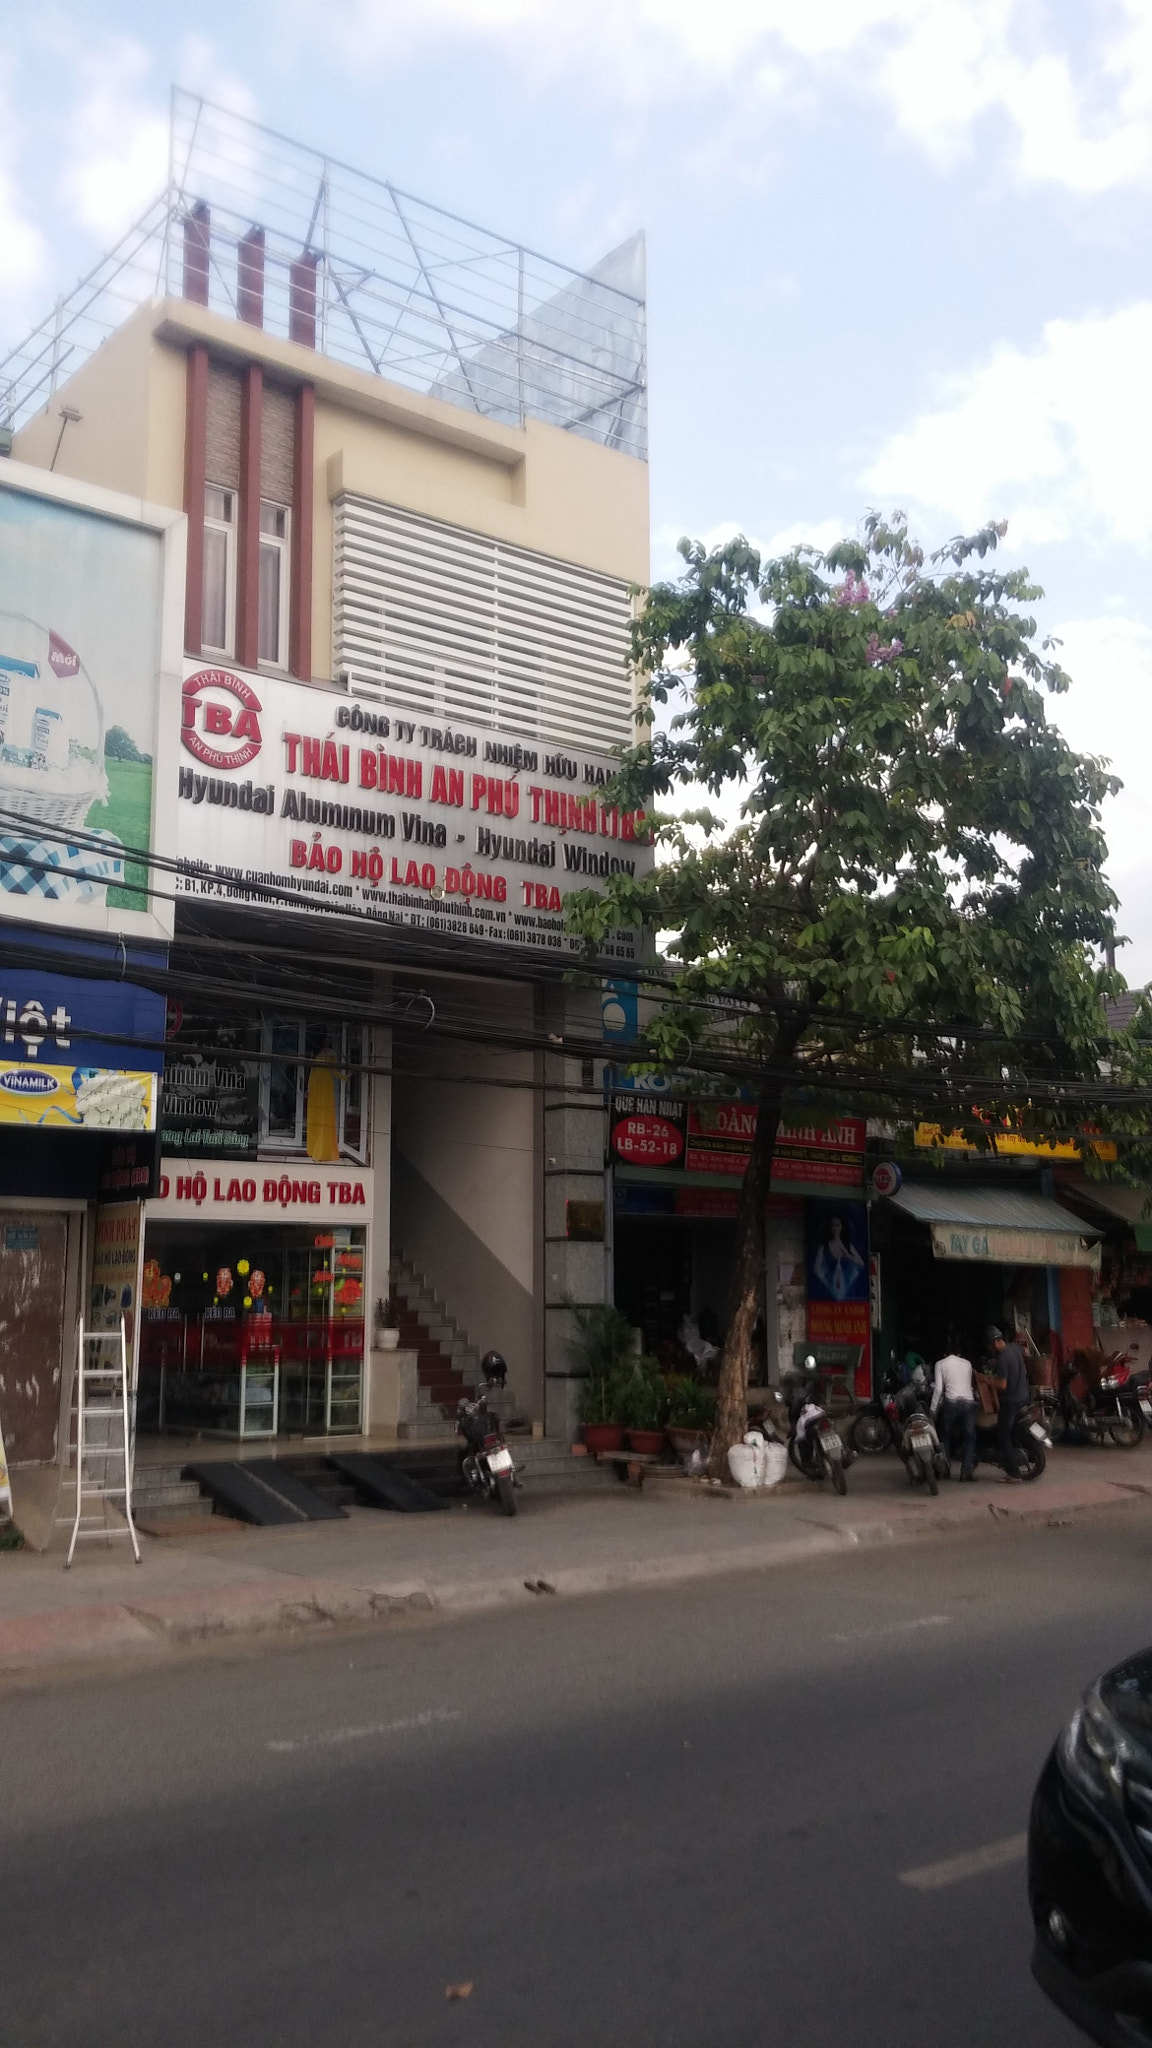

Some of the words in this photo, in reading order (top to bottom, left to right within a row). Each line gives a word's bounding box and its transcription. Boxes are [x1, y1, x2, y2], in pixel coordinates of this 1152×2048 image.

[193, 671, 221, 687] THÁI
[182, 696, 262, 743] TBA
[188, 736, 203, 751] AN
[202, 747, 223, 762] PHÚ
[224, 747, 253, 764] THỊNH
[336, 703, 390, 738] CÔNG
[394, 719, 417, 744] TY
[419, 726, 477, 757] TRÁCH
[483, 740, 538, 774] NHIỆM
[543, 752, 578, 781] HỮU
[282, 731, 350, 784] THÁI
[358, 743, 423, 799] BÌNH
[430, 764, 464, 807] AN
[471, 774, 520, 819] PHÚ
[527, 785, 598, 836] THỊNH
[600, 802, 655, 847] (TB
[178, 766, 275, 815] Hyundai
[280, 788, 396, 839] Aluminum
[401, 811, 447, 848] Vina
[475, 826, 556, 868] Hyundai
[562, 843, 636, 877] Window
[176, 856, 213, 876] ebsite:
[289, 831, 343, 874] BẢO
[350, 846, 384, 888] HỘ
[389, 856, 436, 890] LAO
[441, 862, 507, 904] ĐỘNG
[520, 880, 562, 912] TBA
[0, 996, 72, 1058] iệt
[3, 1074, 55, 1090] VINAMILK
[214, 1066, 246, 1091] Vina
[627, 1121, 669, 1137] RB-26
[703, 1107, 758, 1134] OÀN
[616, 1137, 677, 1155] LB-52-18
[176, 1170, 207, 1206] HỘ
[213, 1176, 257, 1203] LAO
[263, 1174, 321, 1208] ĐỘNG
[327, 1181, 366, 1205] TBA
